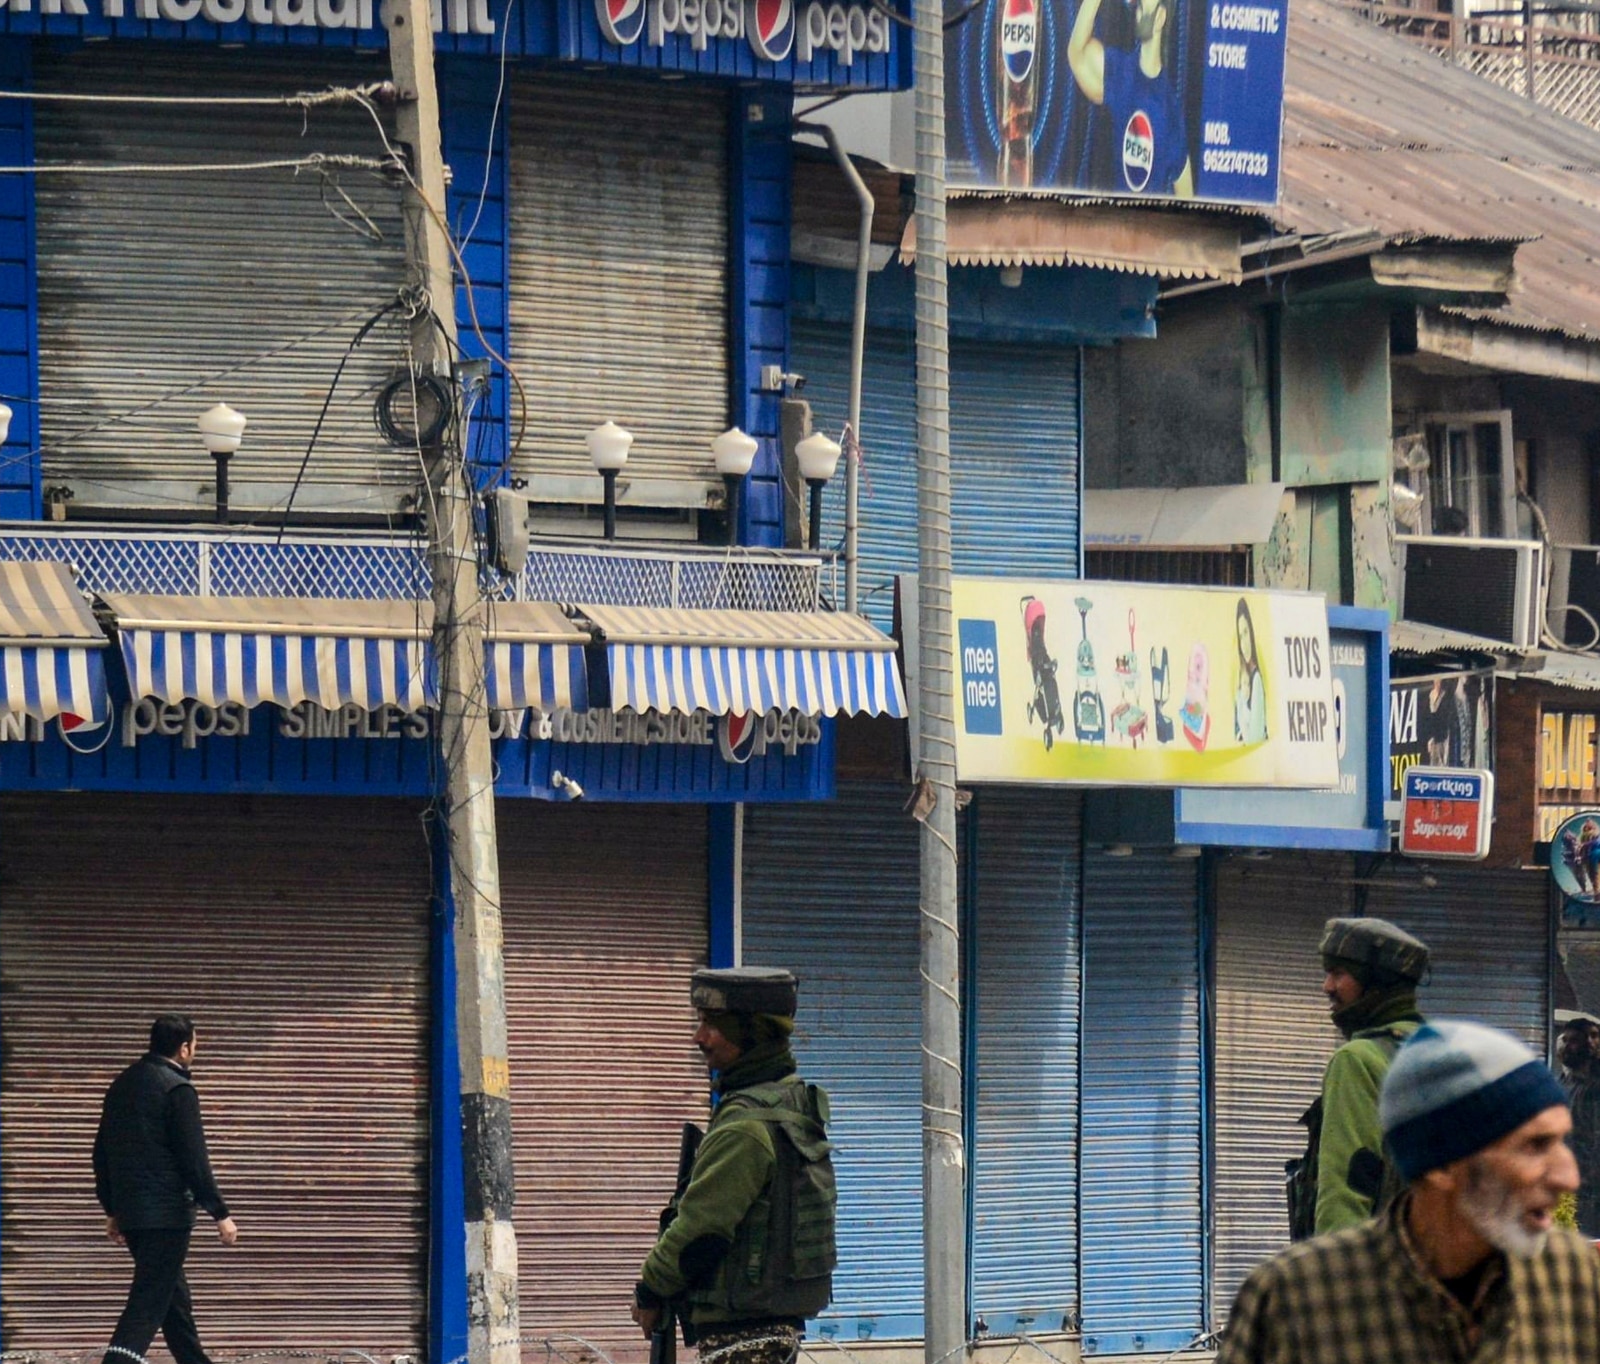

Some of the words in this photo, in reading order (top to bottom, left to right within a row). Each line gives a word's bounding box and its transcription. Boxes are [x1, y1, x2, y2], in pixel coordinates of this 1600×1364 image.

[1003, 23, 1034, 43] PEPSI
[1211, 4, 1220, 28] &
[1221, 5, 1280, 34] COSMETIC
[798, 2, 890, 66] pepsi
[1209, 43, 1247, 69] STORE
[1204, 121, 1231, 146] MOB.
[1125, 140, 1151, 162] PEPSI
[1203, 148, 1269, 177] 9622747333
[964, 647, 995, 675] mee
[1284, 637, 1321, 679] TOYS
[966, 680, 997, 708] mee
[122, 697, 250, 749] pepsi
[1287, 701, 1328, 743] KEMP
[1542, 712, 1596, 790] BLUE
[1414, 778, 1473, 797] Sportking
[1412, 818, 1469, 841] Supersox
